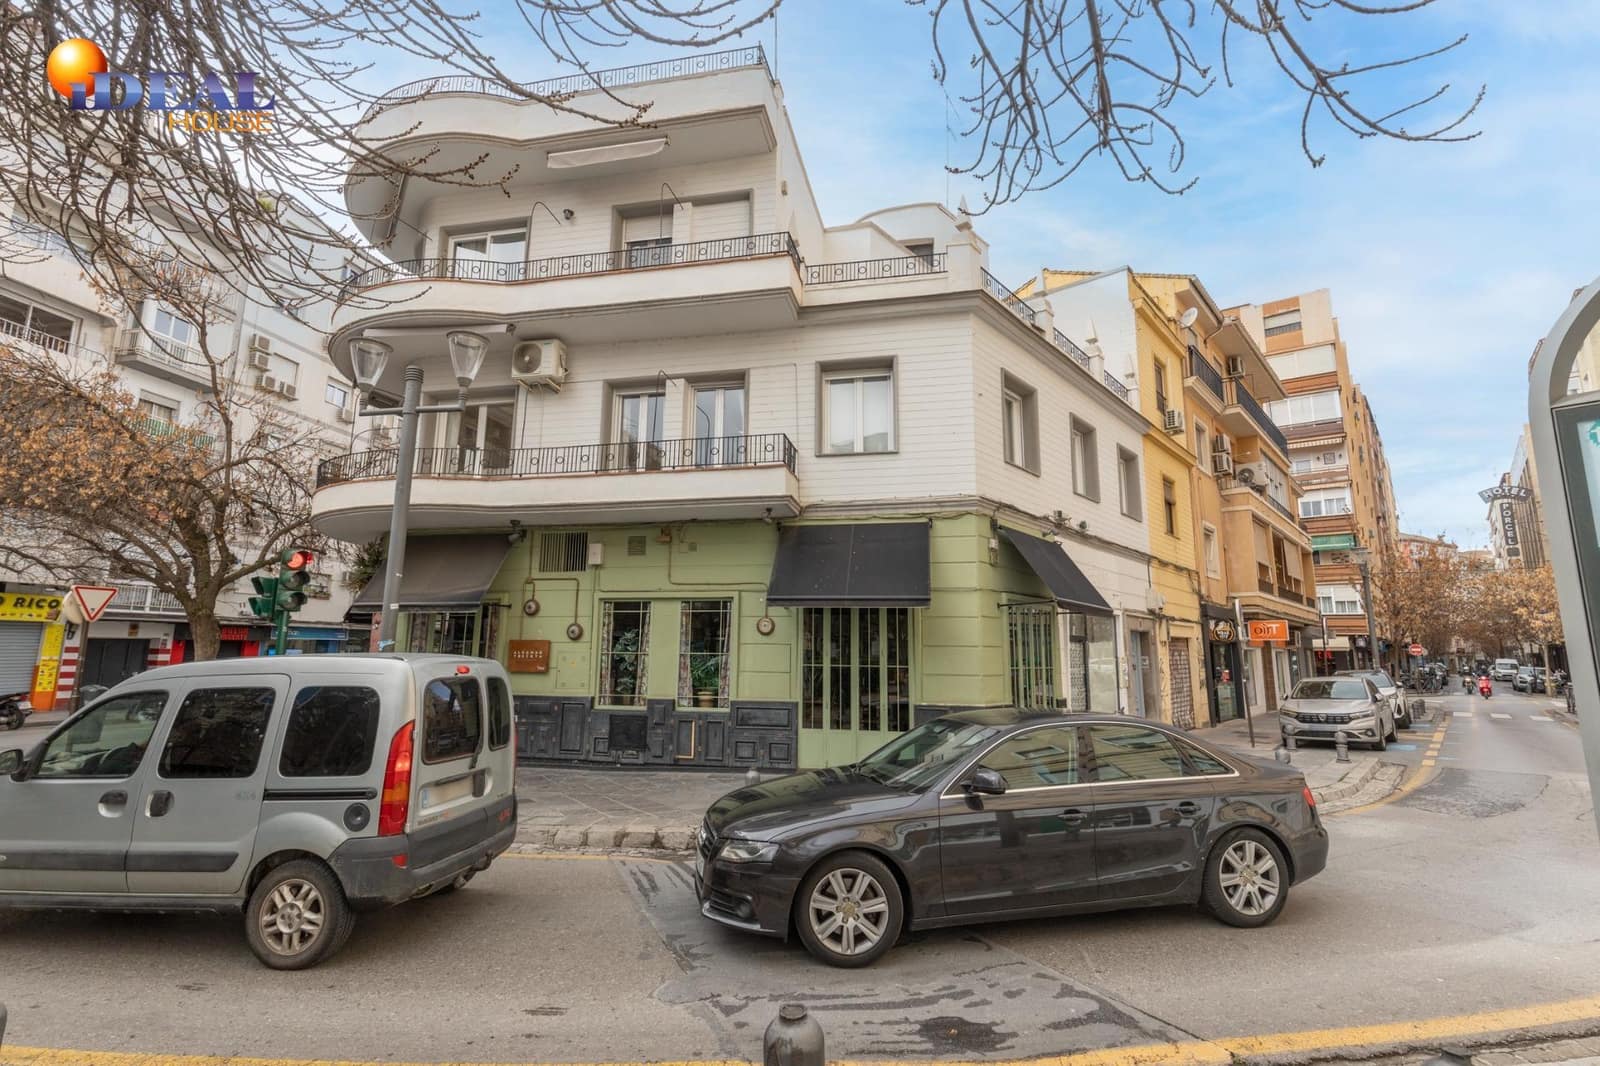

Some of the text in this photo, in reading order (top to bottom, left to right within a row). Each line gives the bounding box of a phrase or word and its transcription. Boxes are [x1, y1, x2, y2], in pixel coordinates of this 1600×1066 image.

[1482, 486, 1527, 498] HOTEL
[1502, 503, 1516, 545] PORCEL
[13, 597, 60, 610] RICO
